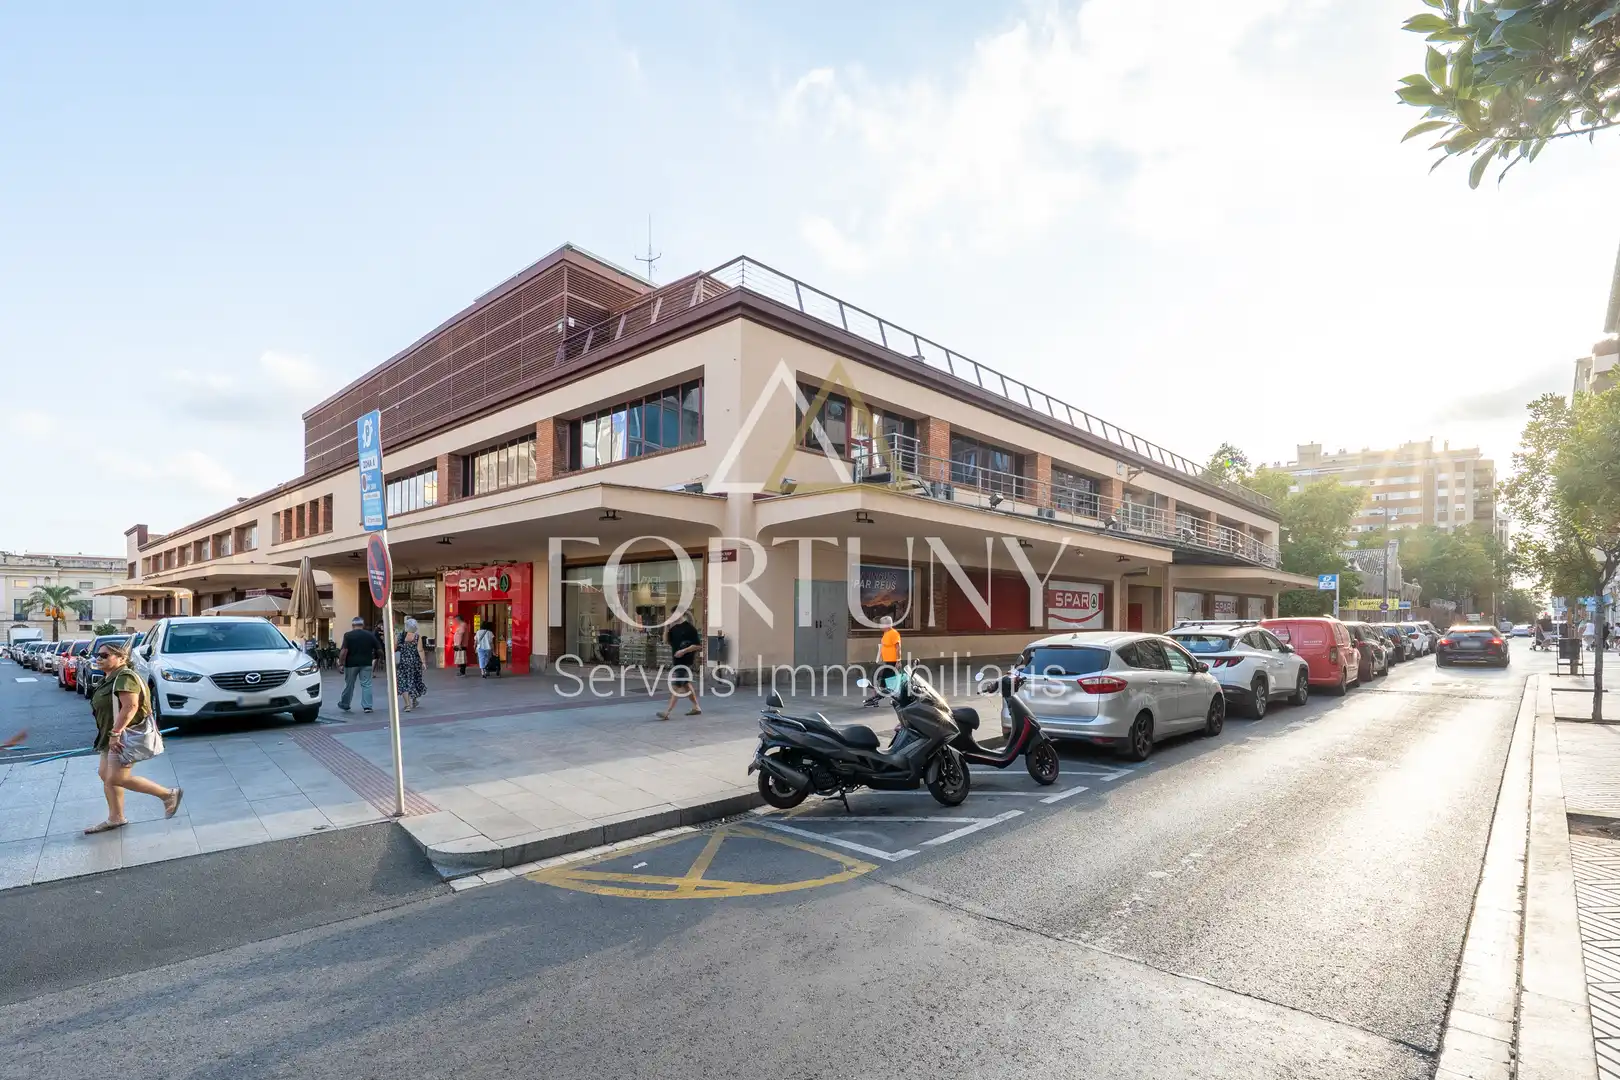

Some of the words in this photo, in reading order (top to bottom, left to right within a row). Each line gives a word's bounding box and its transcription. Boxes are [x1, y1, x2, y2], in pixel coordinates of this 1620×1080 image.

[458, 576, 498, 592] SPAR
[874, 580, 897, 590] REUS
[1055, 592, 1089, 607] SPAR
[1215, 601, 1231, 613] SPAR
